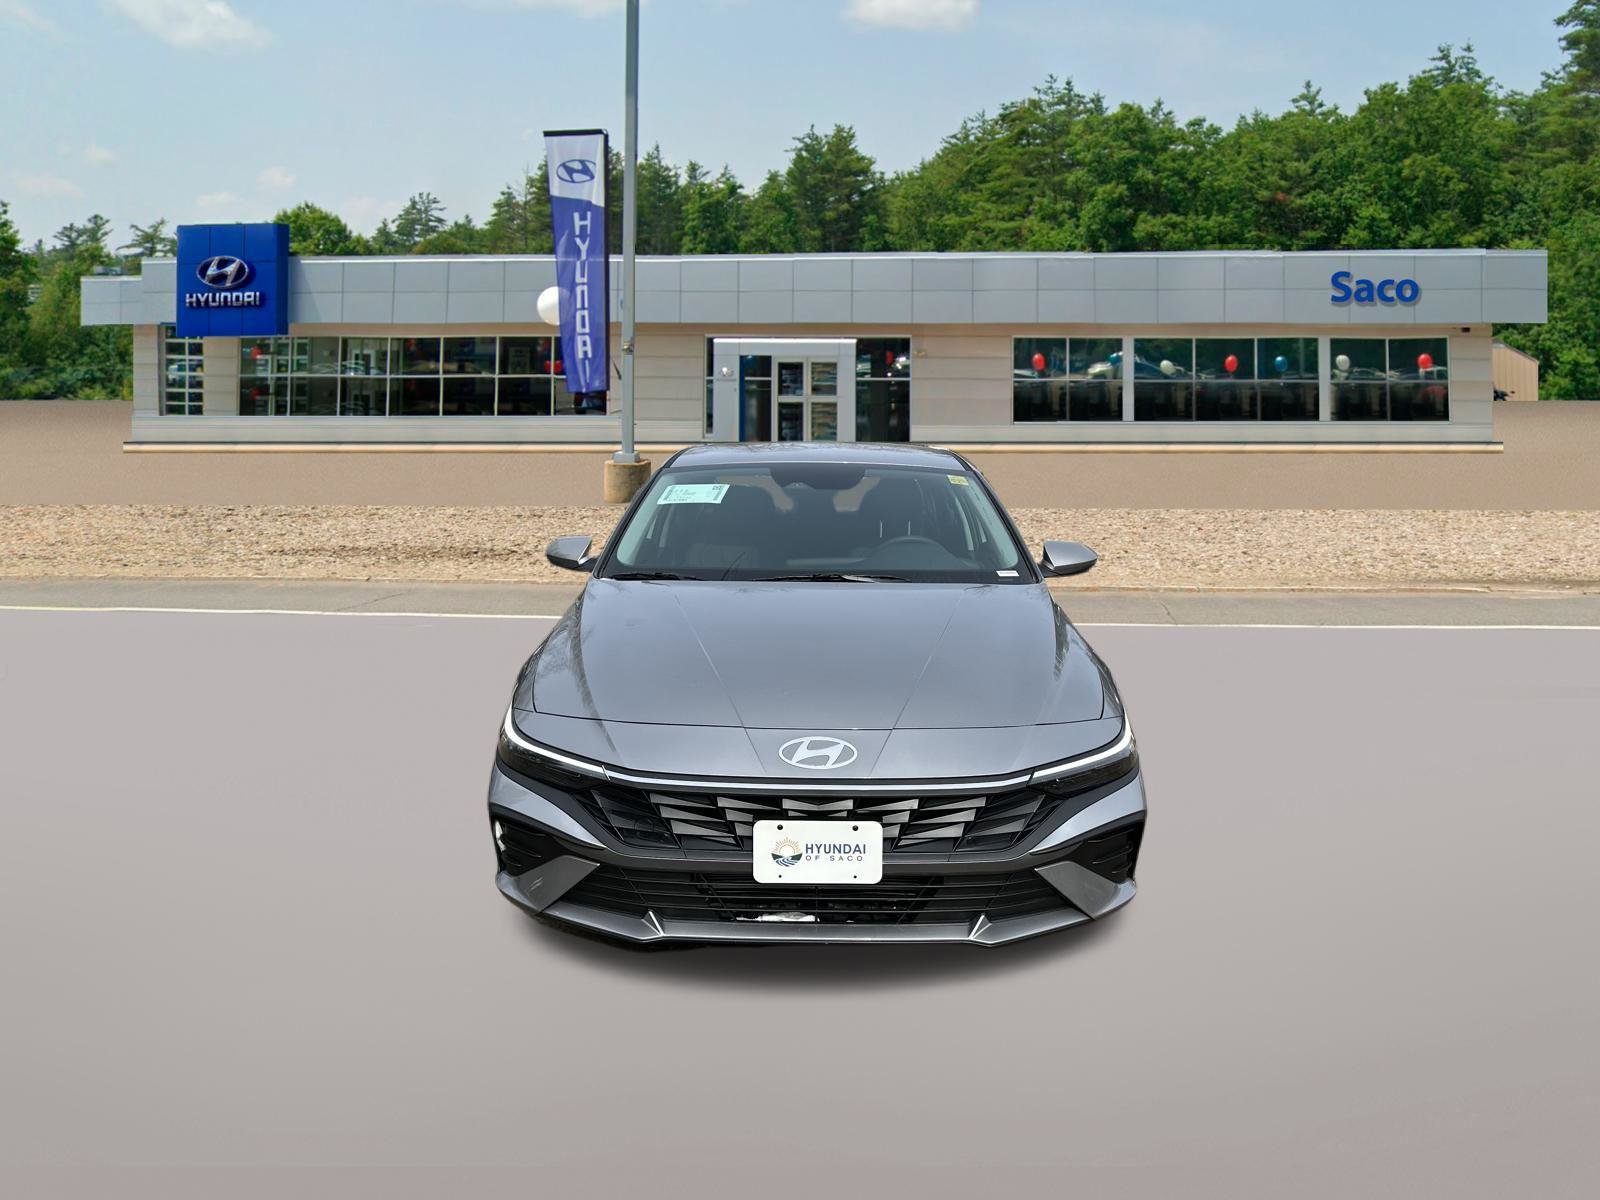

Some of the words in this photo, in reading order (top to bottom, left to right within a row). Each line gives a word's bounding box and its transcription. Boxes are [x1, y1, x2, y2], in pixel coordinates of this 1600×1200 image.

[185, 291, 260, 307] HYUNDAI
[573, 211, 592, 383] HYUNDAI
[1331, 271, 1420, 303] Saco
[805, 843, 866, 854] HYUNDAI
